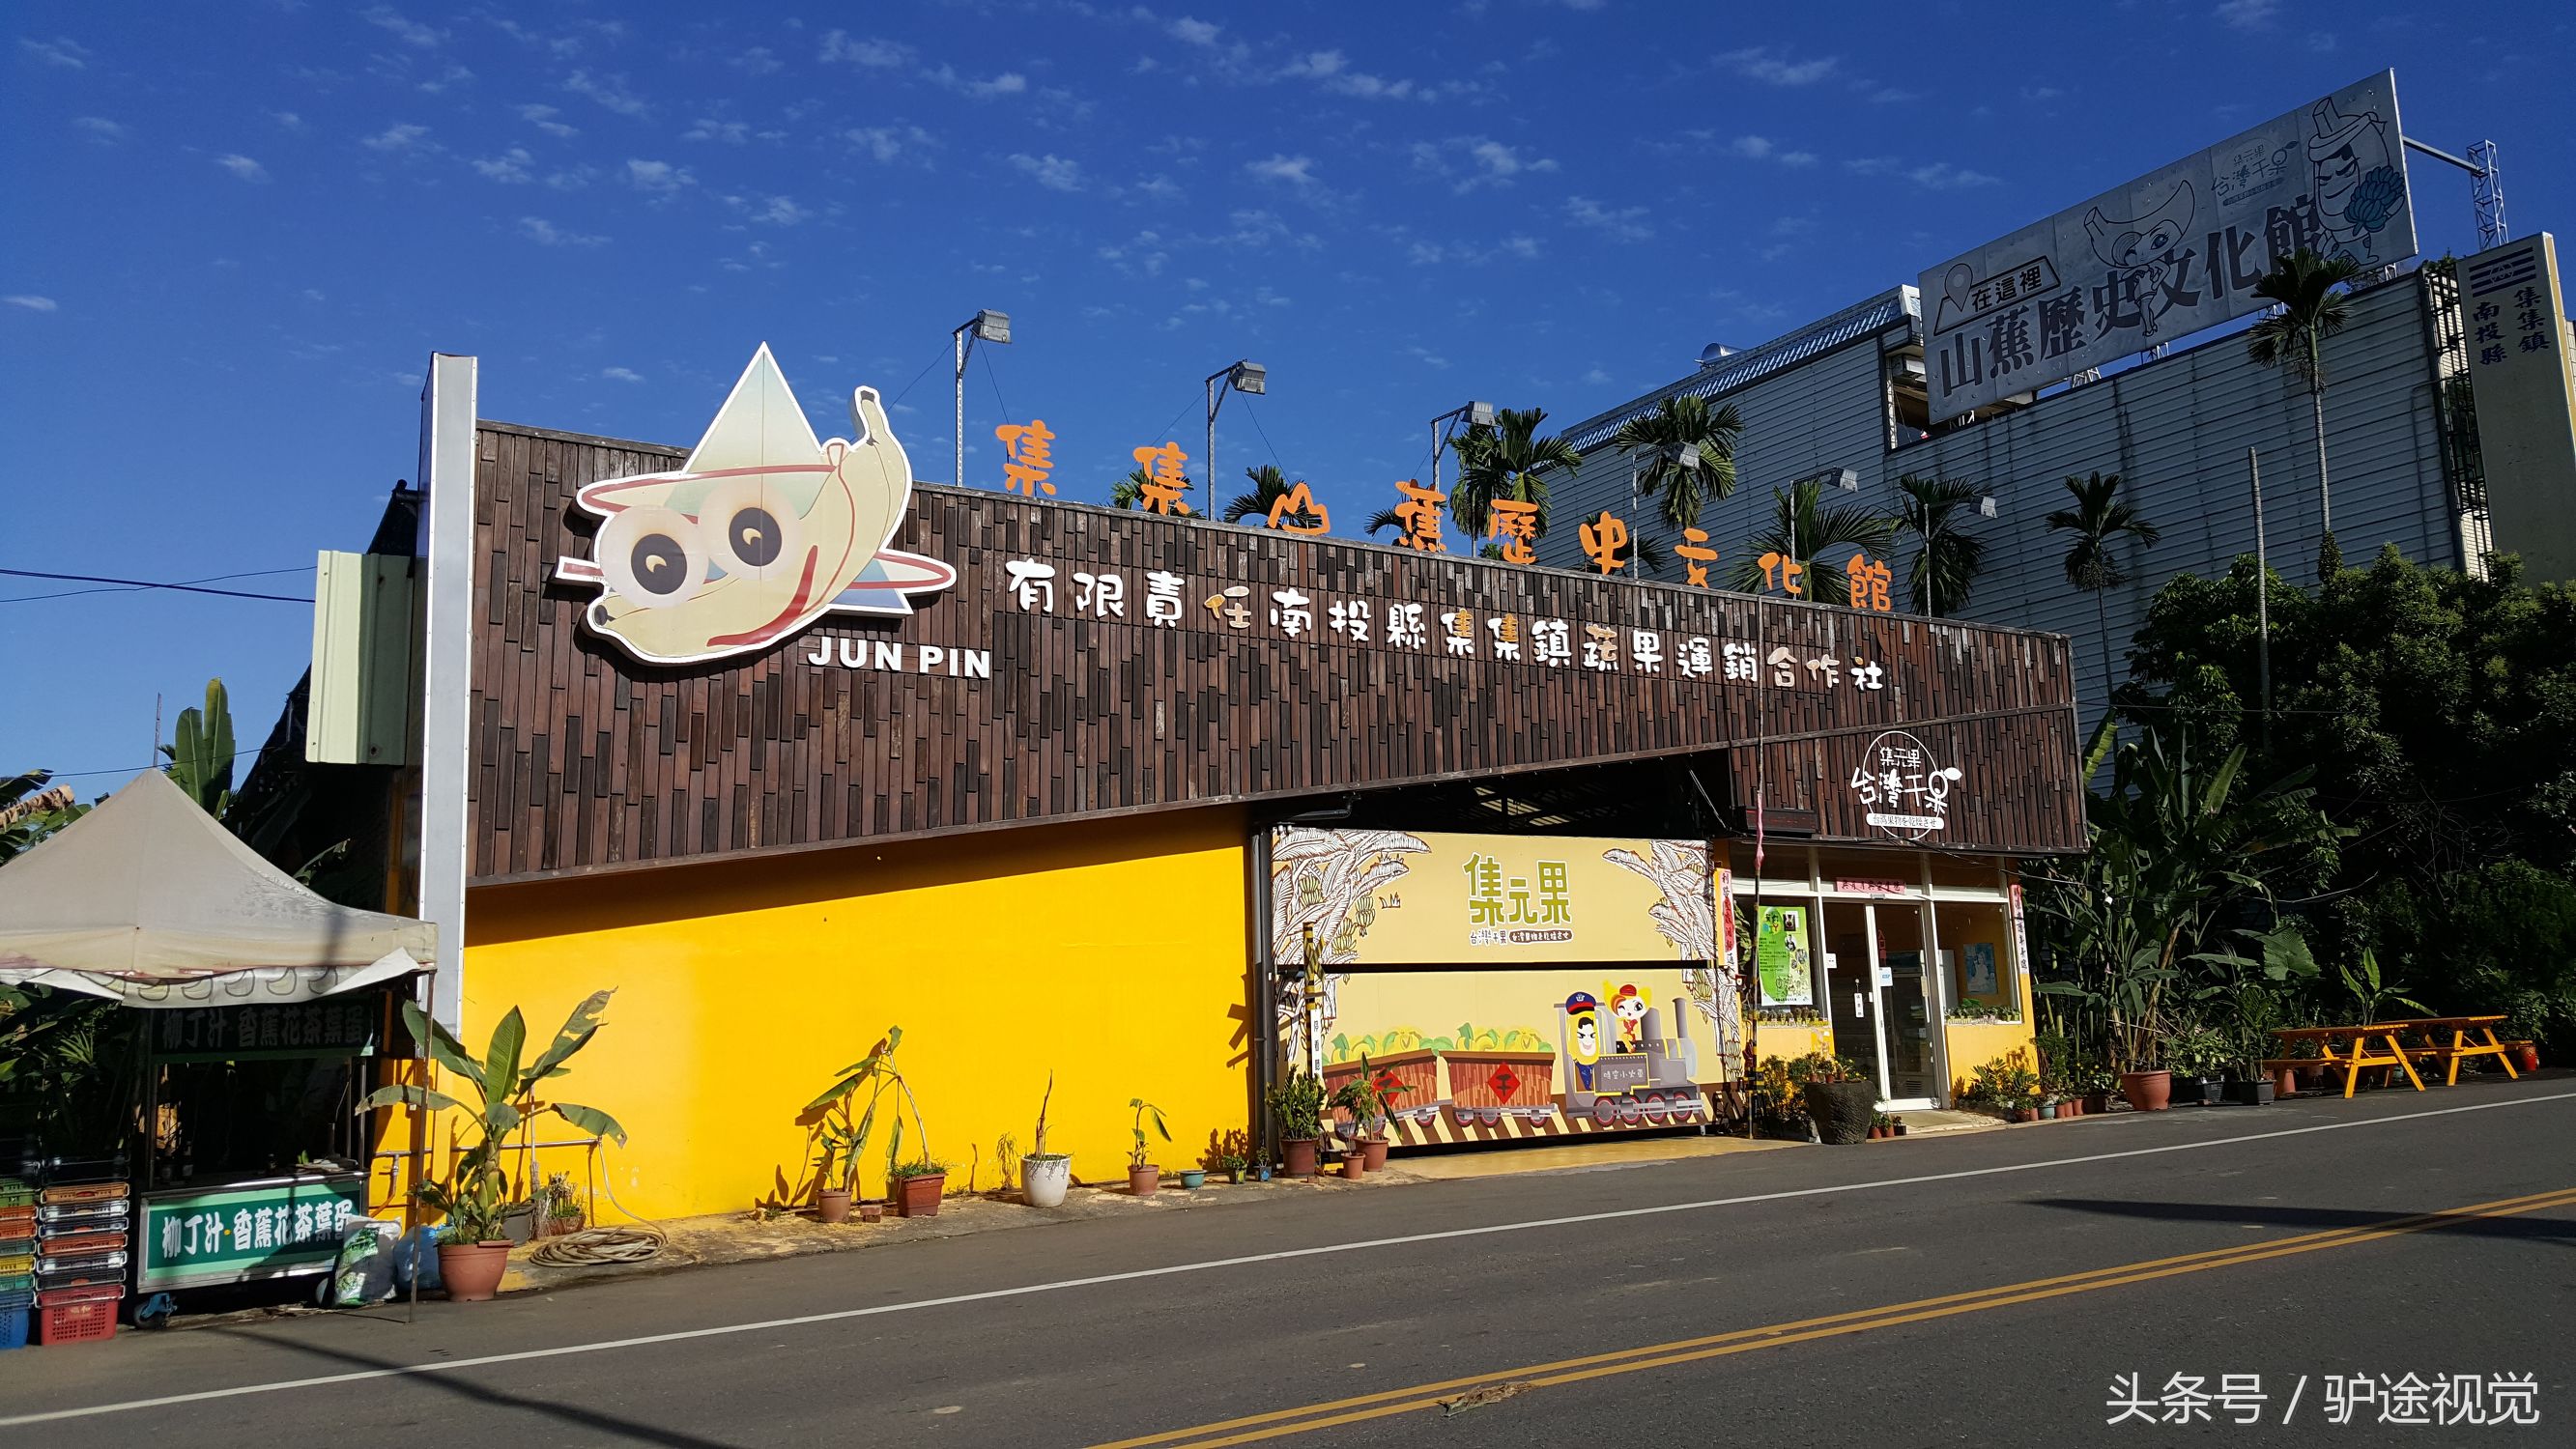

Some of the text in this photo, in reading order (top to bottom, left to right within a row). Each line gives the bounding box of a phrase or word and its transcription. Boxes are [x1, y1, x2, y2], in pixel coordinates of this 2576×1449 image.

[1971, 267, 2043, 313] 在這裡
[2473, 301, 2508, 366] 南投縣
[2513, 286, 2552, 354] 集集鎮
[808, 636, 990, 679] JUN PIN
[1879, 746, 1922, 768] 集元果
[1463, 852, 1572, 927] 集元果
